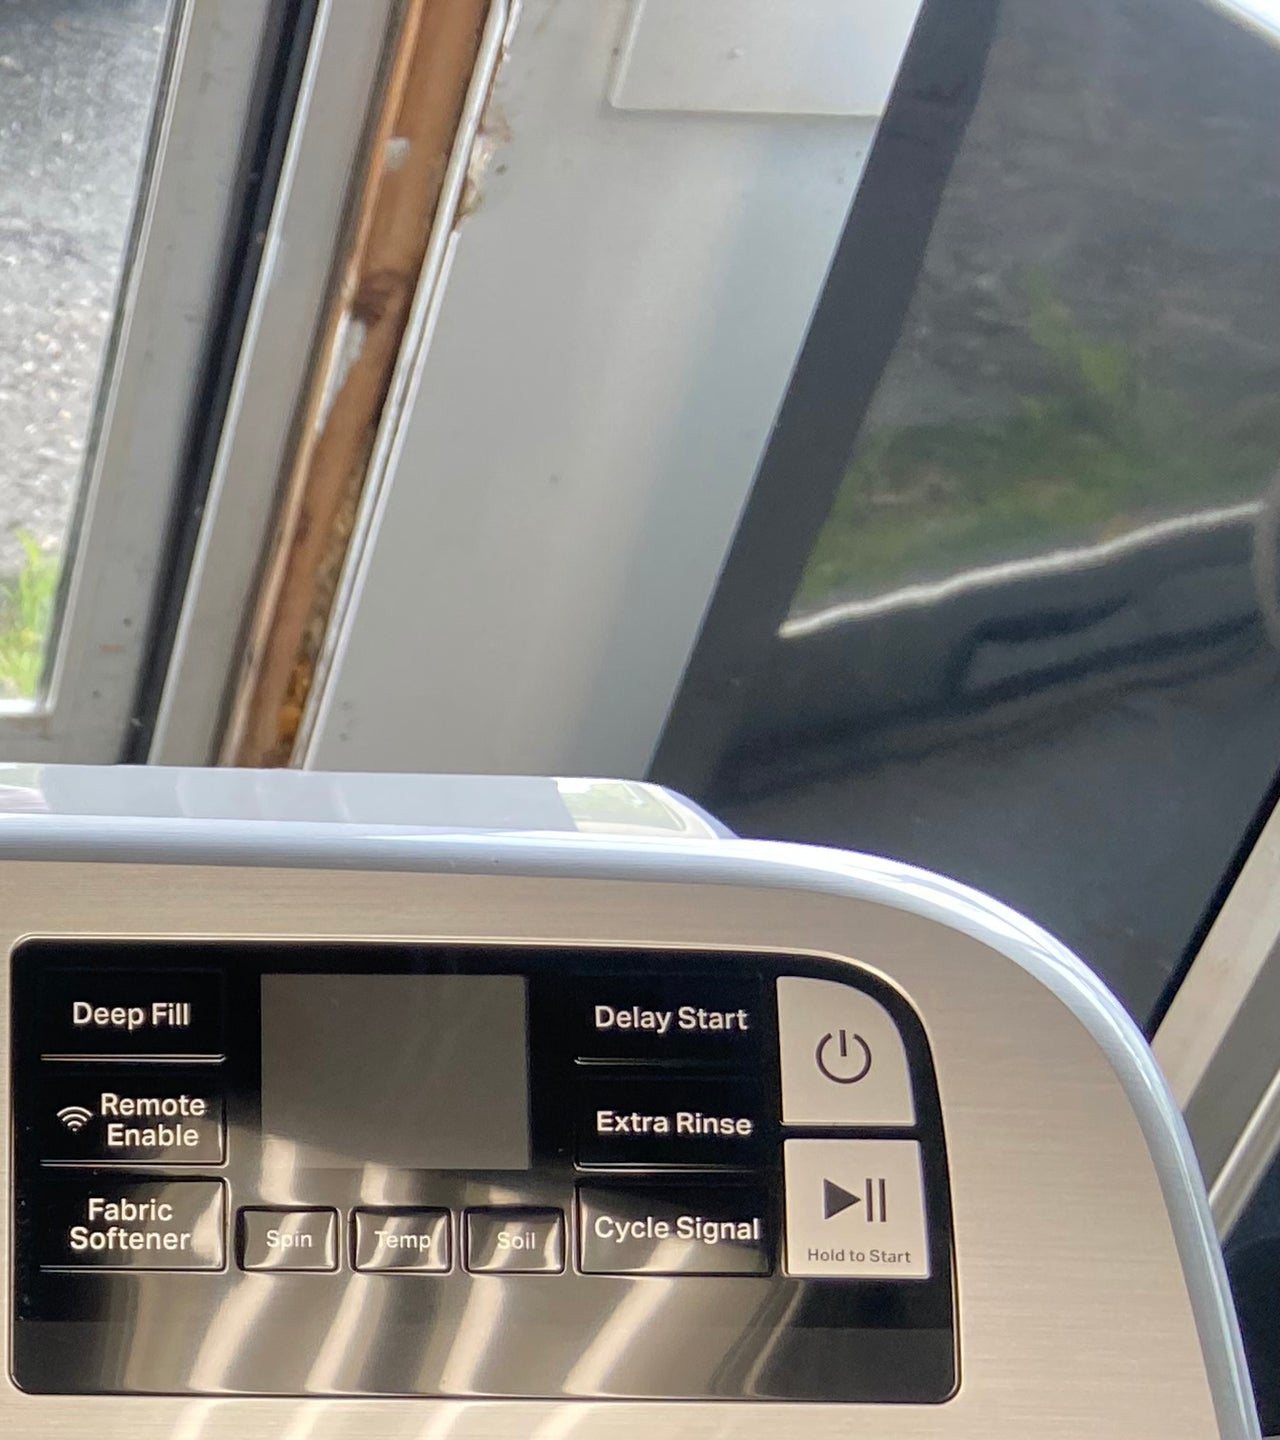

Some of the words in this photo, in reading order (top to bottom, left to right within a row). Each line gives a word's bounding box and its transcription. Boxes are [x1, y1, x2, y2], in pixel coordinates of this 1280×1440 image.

[72, 1001, 144, 1031] Deep
[151, 1002, 191, 1026] Fill
[594, 1005, 672, 1034] Delay
[677, 1006, 749, 1032] Start
[100, 1093, 206, 1117] Remote
[106, 1123, 199, 1147] Enable
[596, 1110, 669, 1134] Extra
[676, 1112, 753, 1136] Rinse
[87, 1197, 173, 1222] Fabric
[69, 1226, 191, 1251] Softener
[265, 1229, 313, 1253] Spin
[374, 1230, 432, 1254] Temp
[496, 1232, 537, 1251] Soil
[593, 1216, 670, 1244] Cycle
[675, 1217, 761, 1245] Signal
[807, 1247, 845, 1264] Hold
[849, 1249, 865, 1264] to
[869, 1249, 912, 1265] Start
